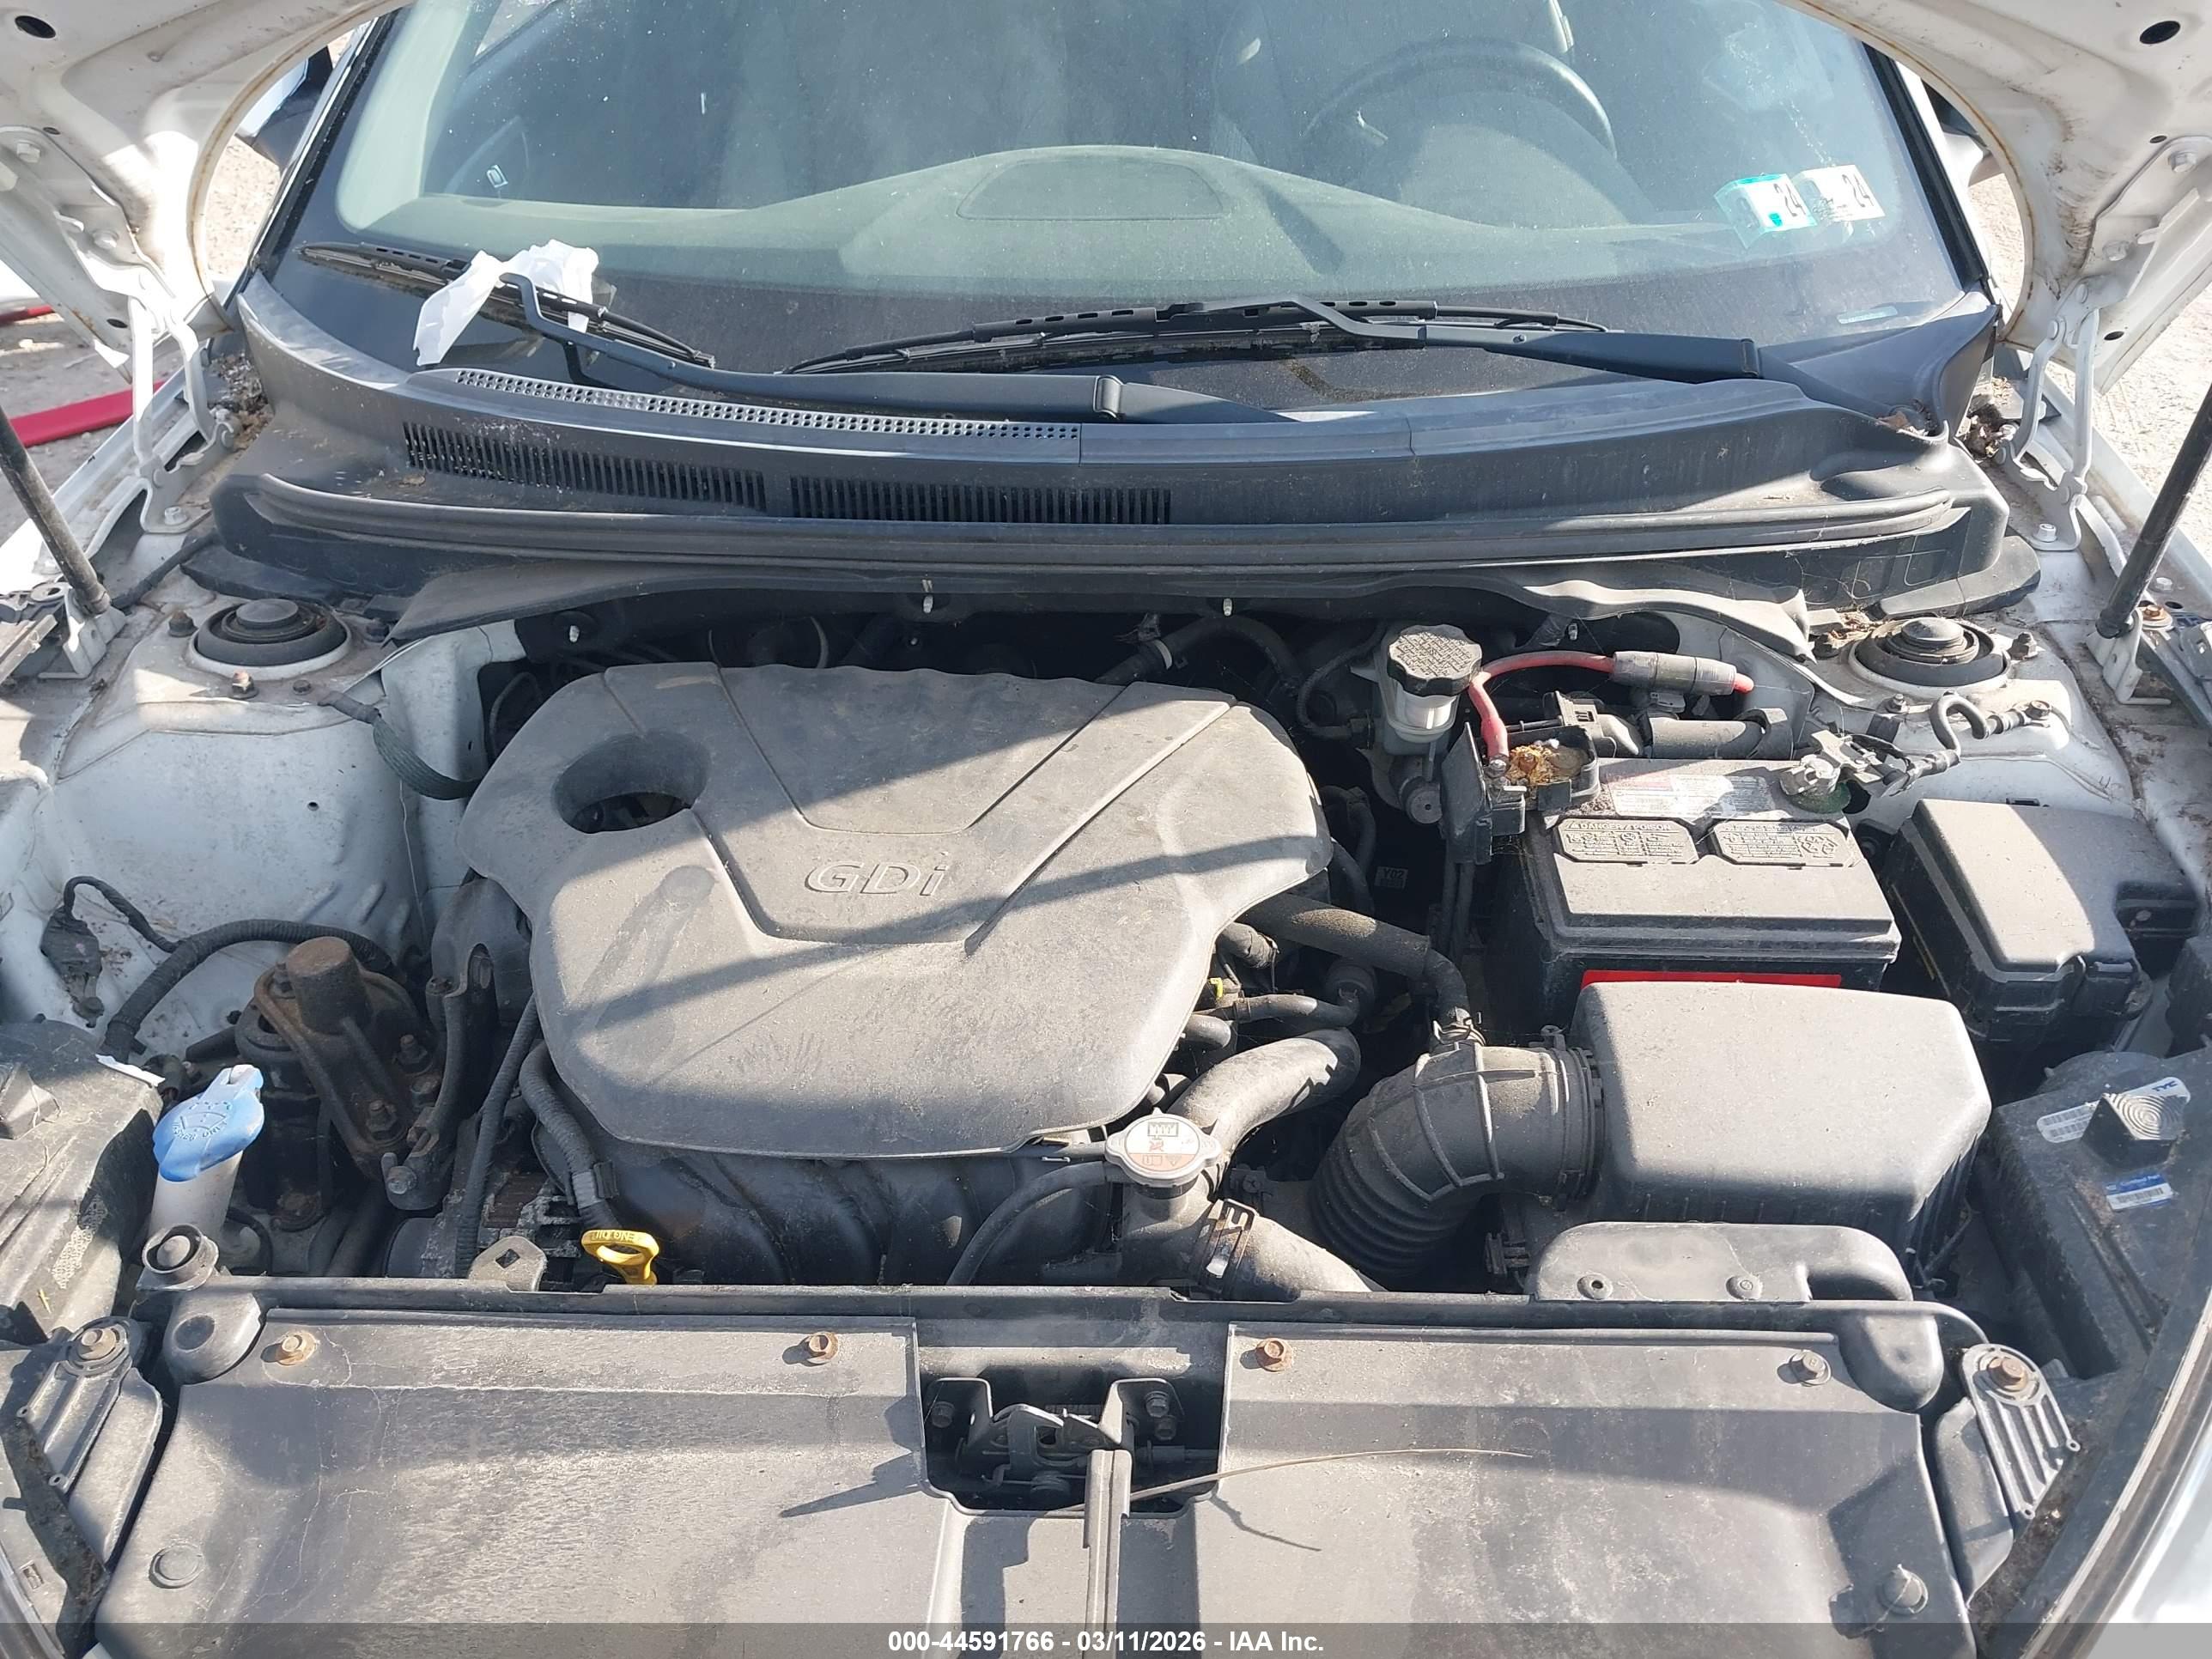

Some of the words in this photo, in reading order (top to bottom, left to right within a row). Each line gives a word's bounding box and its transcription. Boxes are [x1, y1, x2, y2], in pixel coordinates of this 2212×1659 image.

[1773, 183, 1807, 217] 24
[1841, 173, 1875, 208] 24
[804, 851, 950, 896] GDi
[2152, 1080, 2179, 1092] TYC
